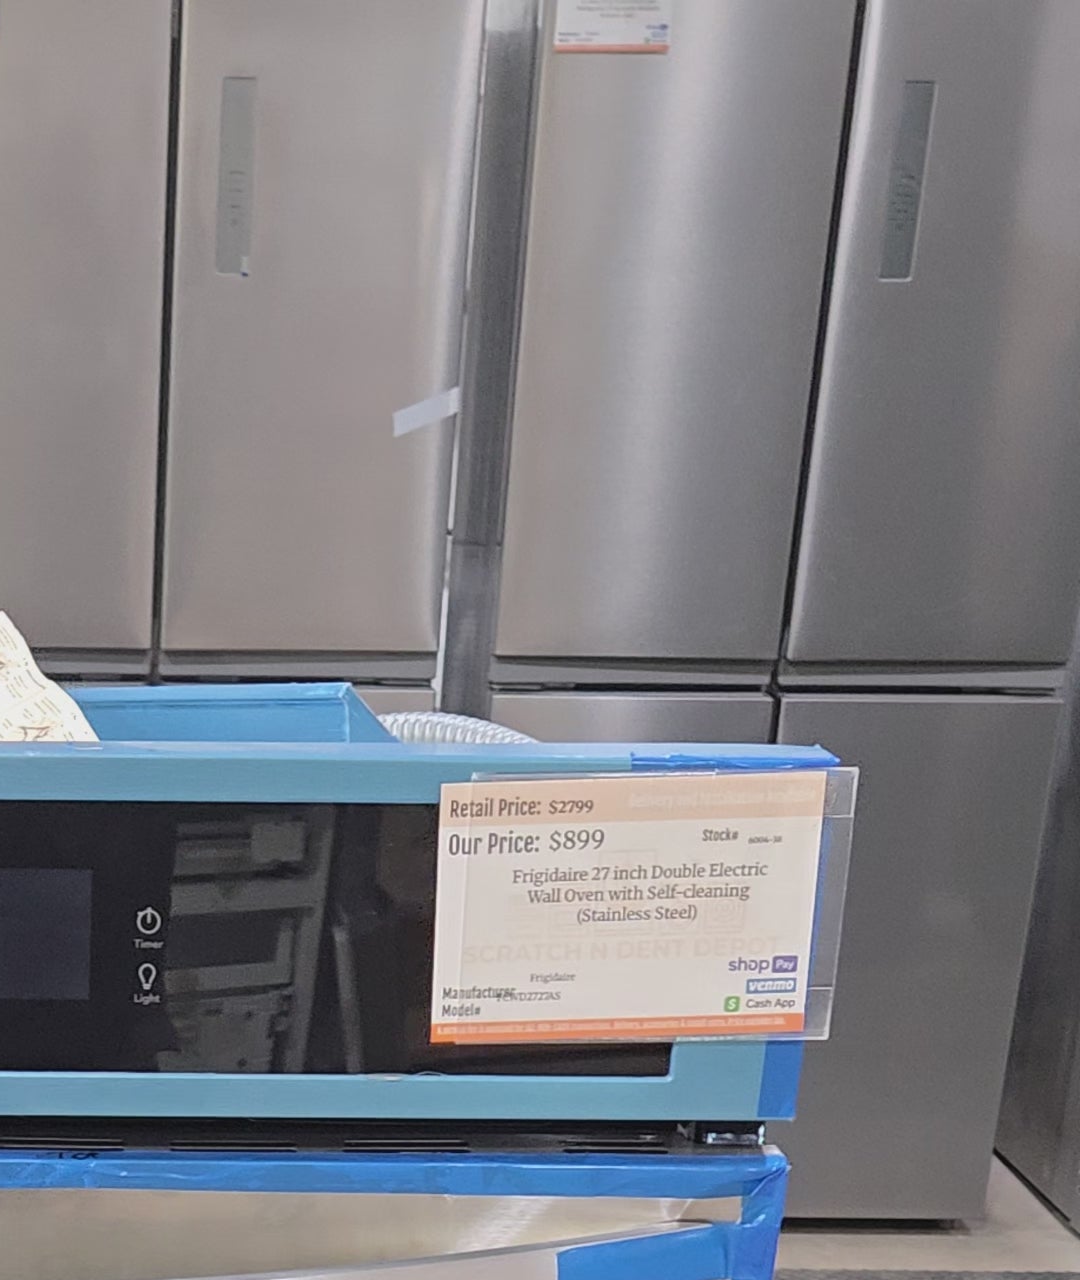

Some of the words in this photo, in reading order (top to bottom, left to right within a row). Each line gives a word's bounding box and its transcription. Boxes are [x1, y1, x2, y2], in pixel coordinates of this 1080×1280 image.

[450, 797, 493, 818] Retail
[498, 797, 541, 816] Price:
[548, 799, 594, 815] $2799
[449, 833, 482, 856] Our
[488, 830, 540, 854] Price:
[549, 829, 605, 852] $899
[512, 867, 588, 887] Frigidaire
[592, 866, 610, 880] 27
[613, 865, 647, 880] inch
[651, 863, 706, 879] Double
[709, 862, 768, 877] Electric
[528, 888, 561, 903] Wall
[564, 888, 604, 902] Oven
[608, 886, 643, 901] with
[647, 883, 751, 901] Self-cleaning
[577, 906, 651, 925] (Stainless
[654, 904, 697, 922] Steel)
[133, 938, 164, 949] Timer
[728, 957, 770, 974] shop
[775, 958, 795, 970] Pay
[748, 980, 795, 992] venmo
[133, 993, 161, 1005] Light
[745, 998, 772, 1008] Cash
[774, 998, 796, 1009] App
